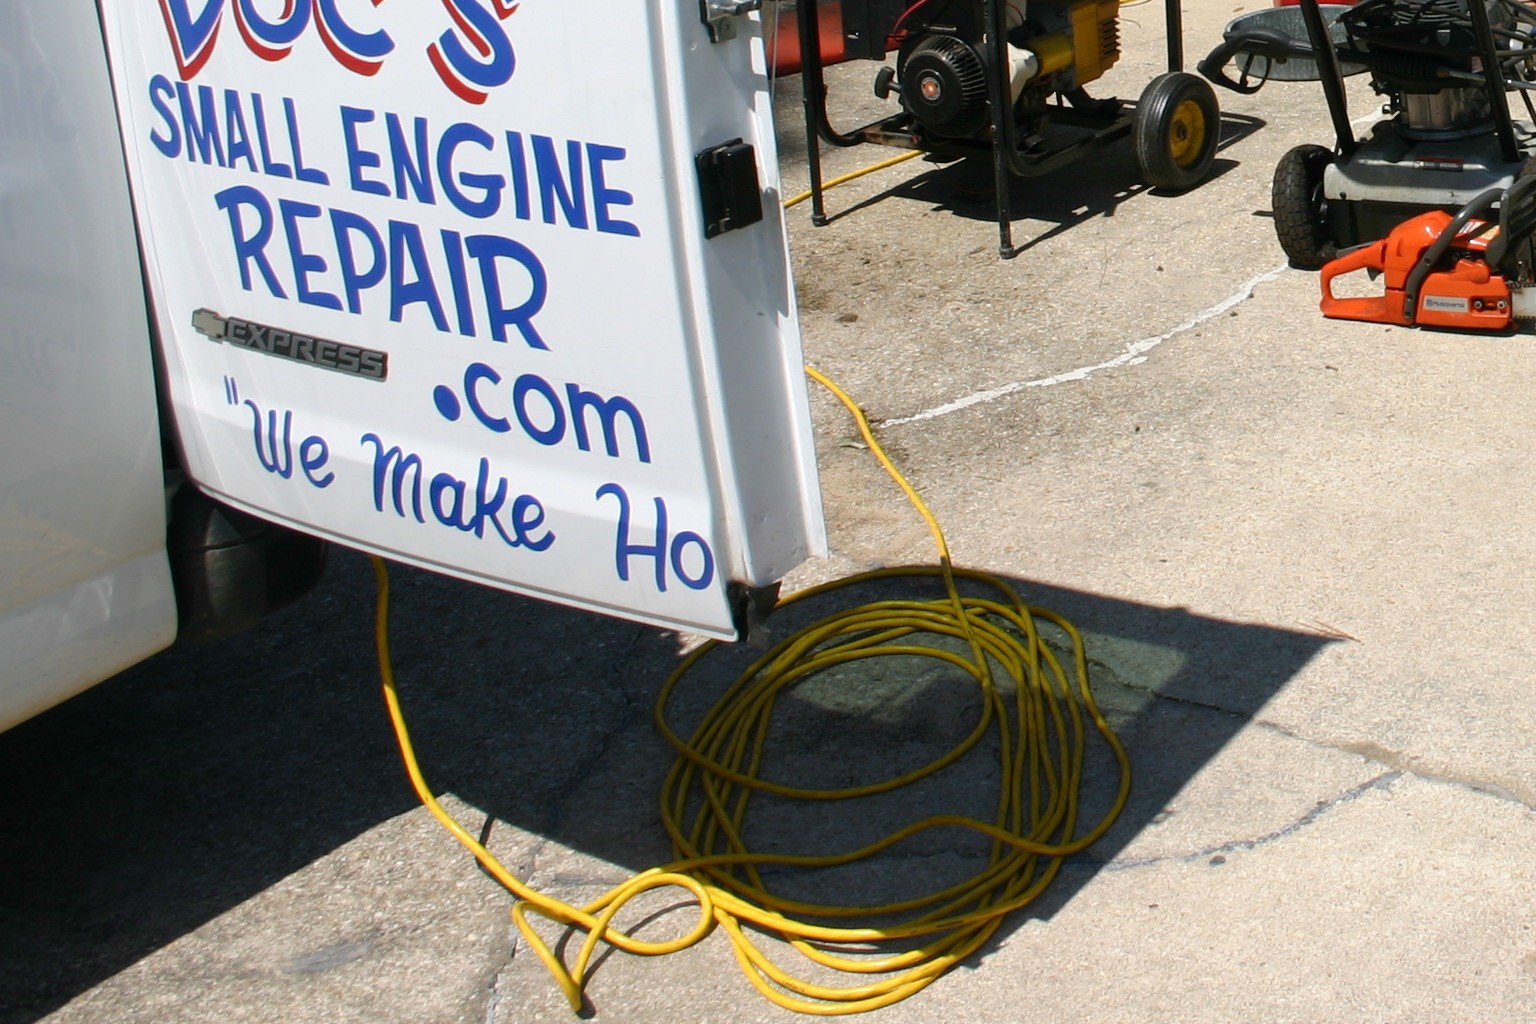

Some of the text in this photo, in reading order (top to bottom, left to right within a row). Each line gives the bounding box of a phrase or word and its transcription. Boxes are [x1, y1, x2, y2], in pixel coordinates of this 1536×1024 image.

[149, 74, 329, 185] SMALL
[341, 105, 642, 239] ENGINE
[216, 185, 552, 352] REPAIR
[227, 320, 384, 378] EXPRESS
[432, 362, 652, 464] .com
[595, 482, 716, 594] Ho
